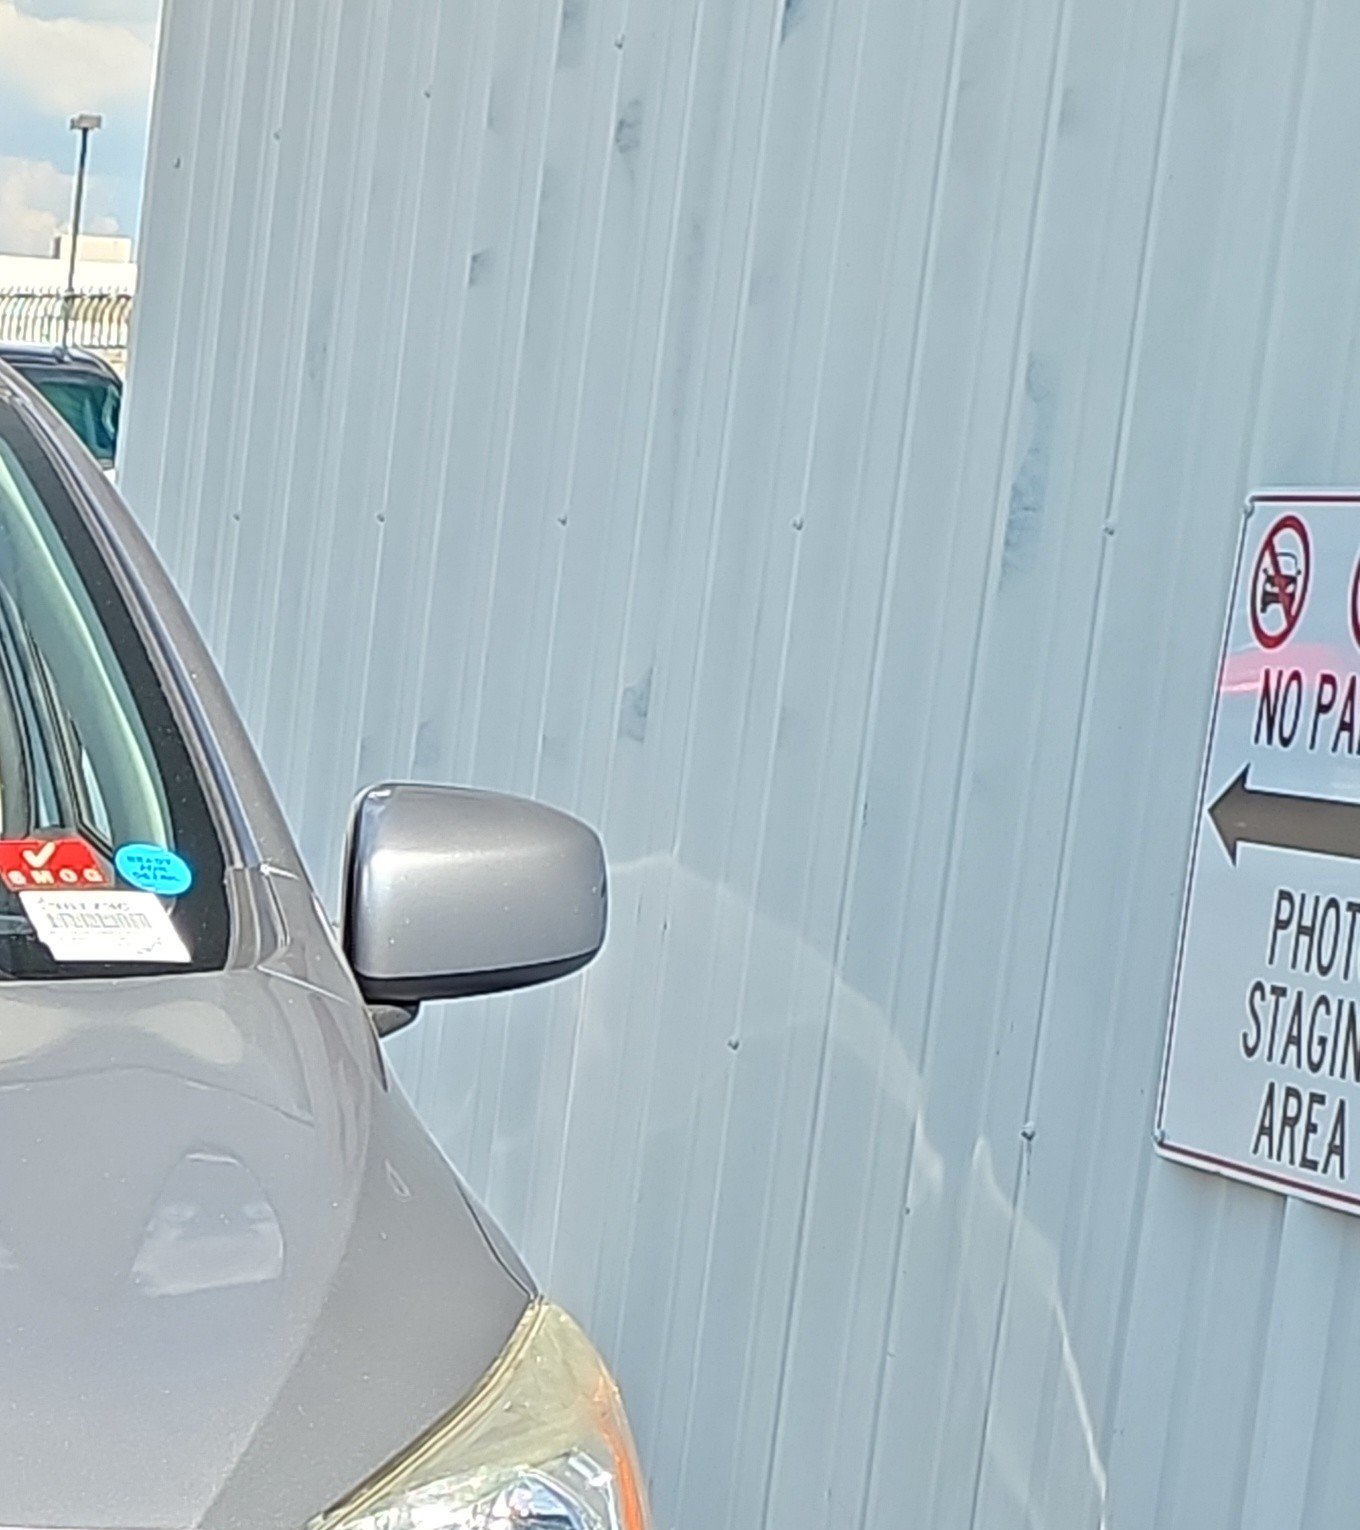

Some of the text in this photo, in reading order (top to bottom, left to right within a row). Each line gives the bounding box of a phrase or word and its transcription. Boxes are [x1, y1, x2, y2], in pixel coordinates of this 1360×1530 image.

[1253, 668, 1360, 756] NO PA
[7, 867, 103, 886] SMOG
[1252, 1080, 1347, 1180] AREA
